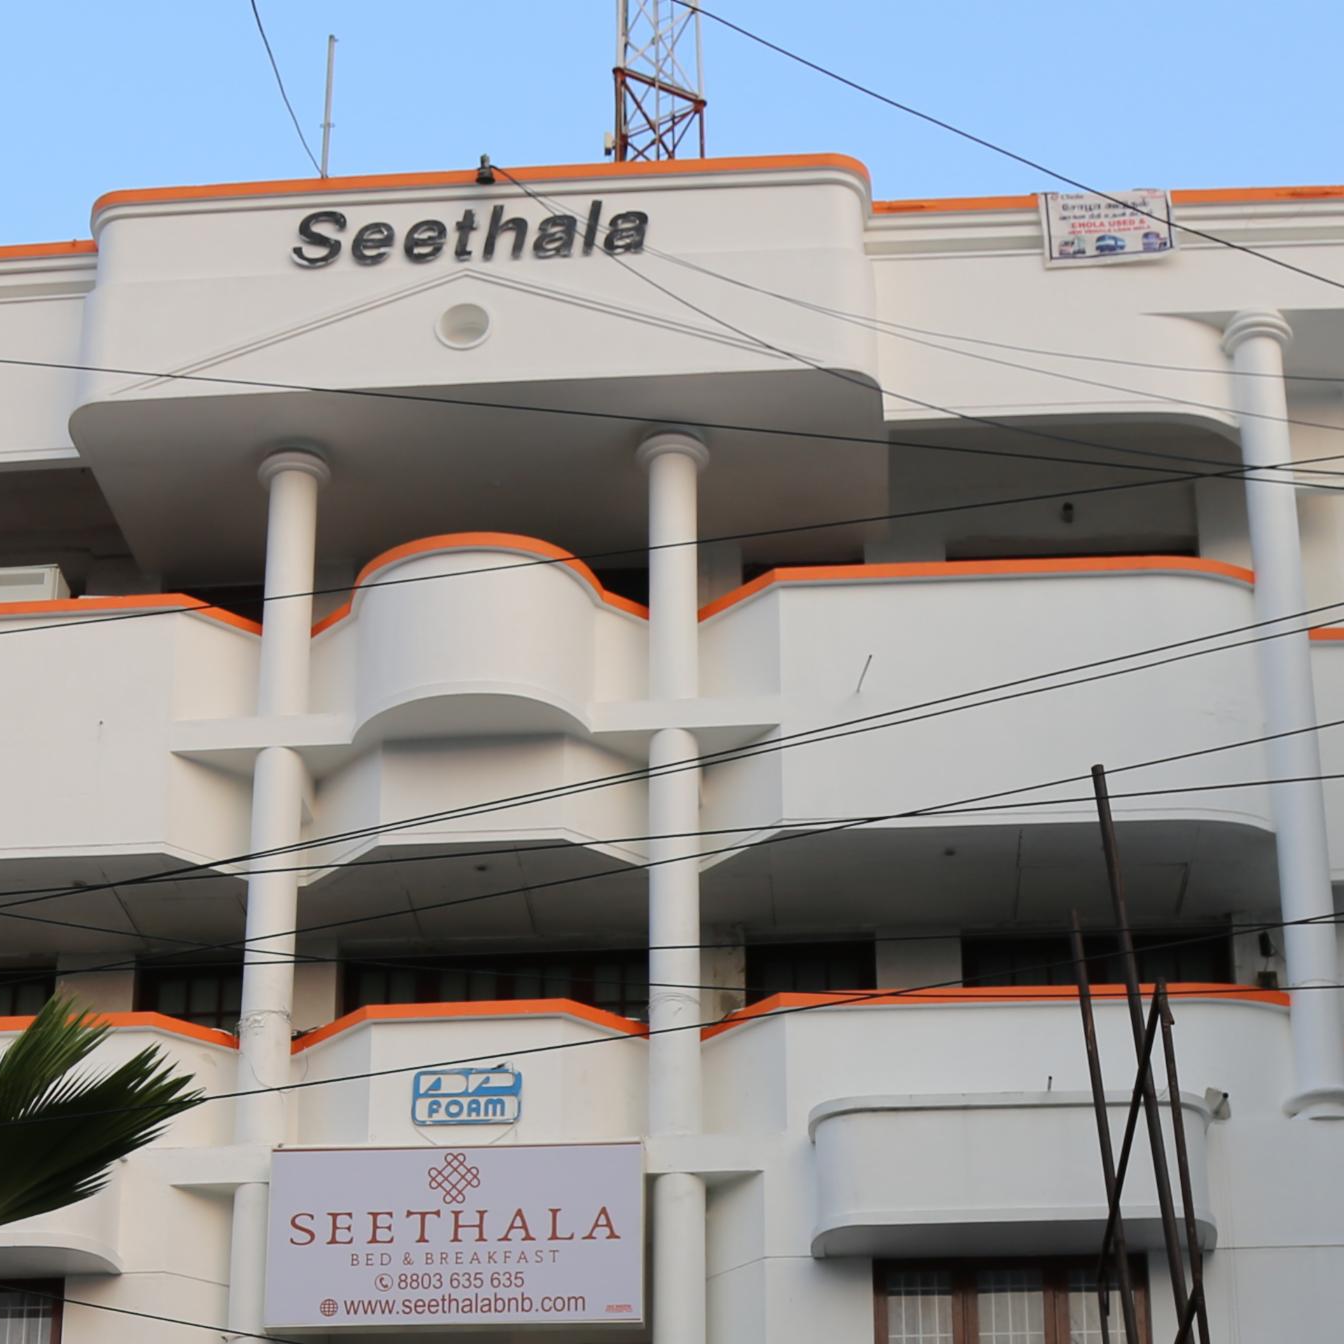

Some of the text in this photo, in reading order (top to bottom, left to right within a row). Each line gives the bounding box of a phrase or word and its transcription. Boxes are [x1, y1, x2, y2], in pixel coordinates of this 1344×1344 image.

[290, 200, 649, 268] Seethala
[427, 1098, 506, 1118] FOAM
[289, 1206, 622, 1246] SEETHALA
[350, 1249, 561, 1266] BED & BREAKFAST
[397, 1271, 525, 1290] 8803 635 635
[344, 1292, 586, 1317] www.seethalabnb.com
